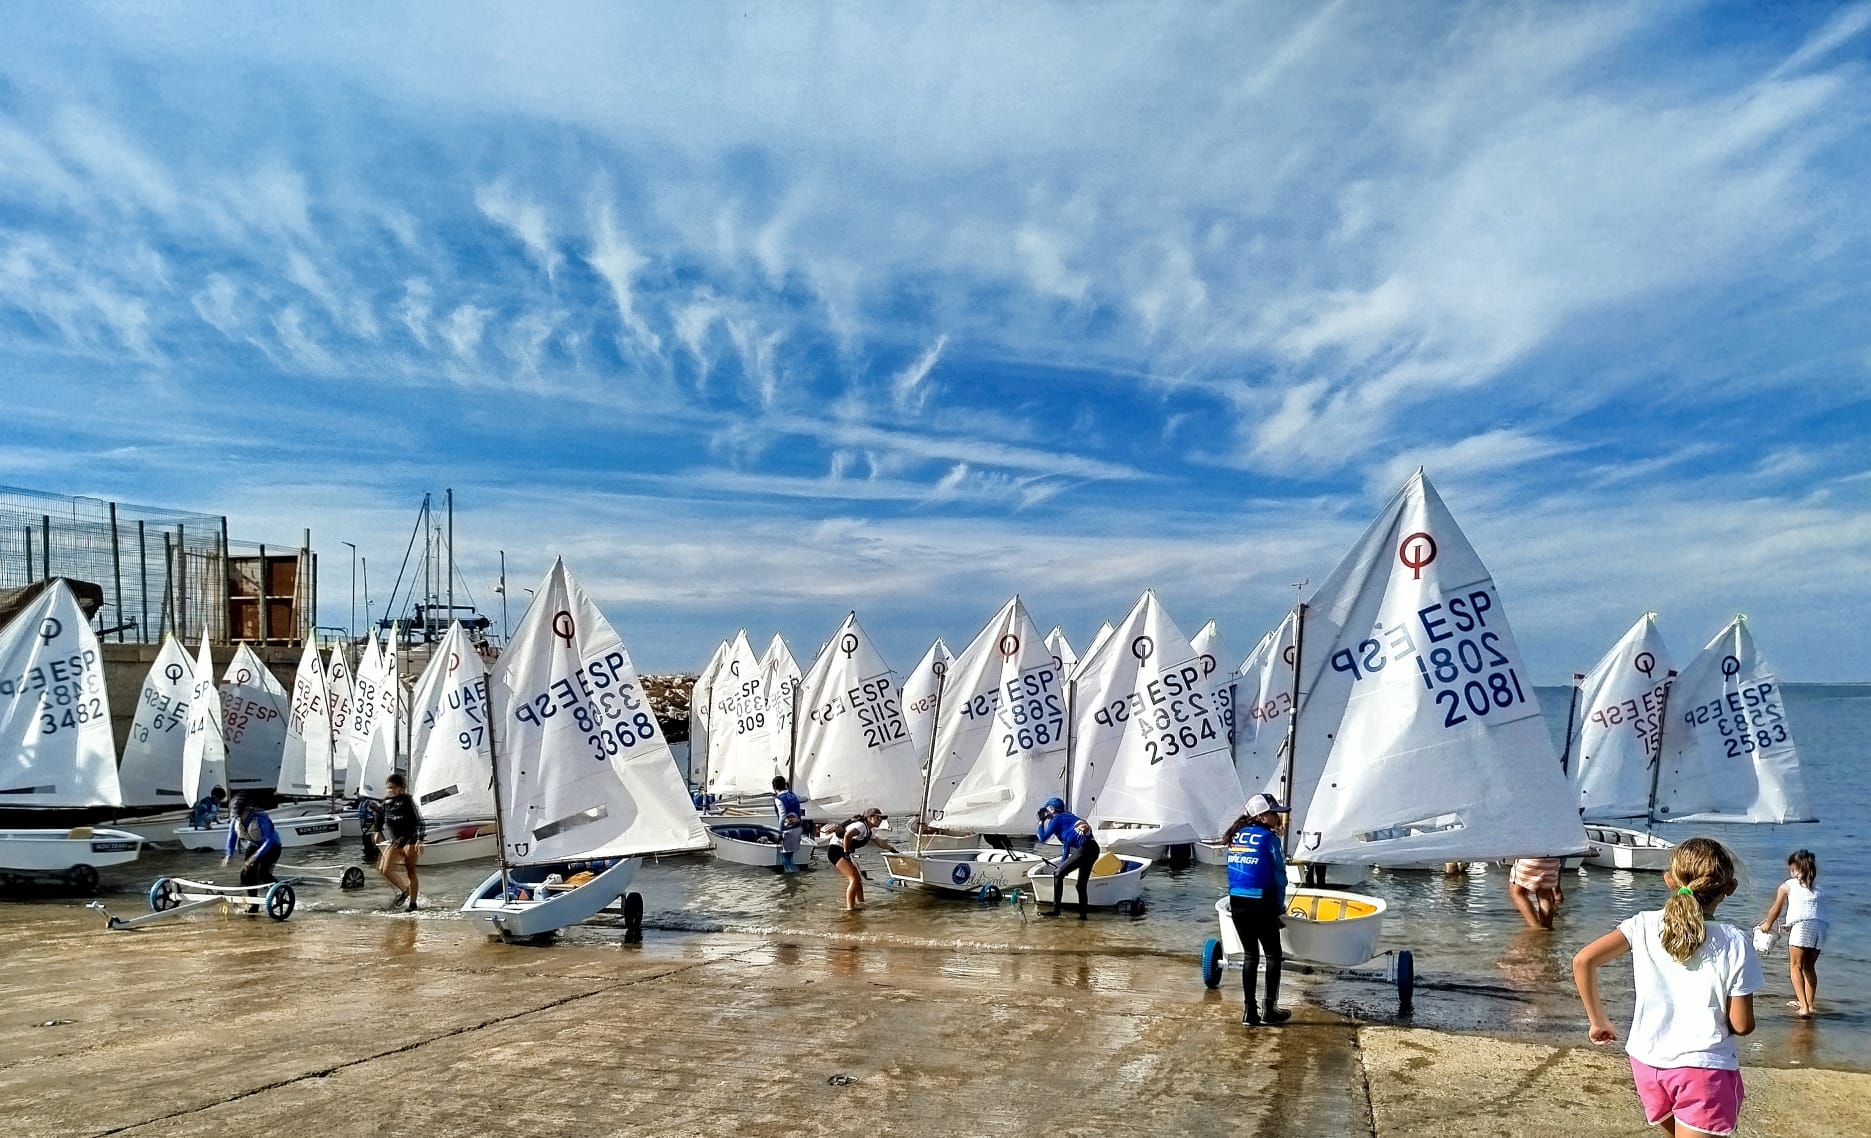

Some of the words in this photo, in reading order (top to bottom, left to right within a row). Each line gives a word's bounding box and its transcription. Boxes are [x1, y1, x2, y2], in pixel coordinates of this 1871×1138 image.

[1417, 590, 1492, 644] ESP
[49, 649, 95, 682] ESP
[575, 652, 624, 698] ESP
[448, 681, 486, 710] UAE
[848, 678, 890, 708] ESP
[1006, 670, 1053, 702] ESP
[1147, 667, 1198, 706] ESP
[1435, 668, 1526, 728] 2081
[1726, 683, 1772, 712] ESP
[40, 698, 103, 734] 3482
[153, 713, 179, 733] 67
[244, 702, 278, 722] ESP
[737, 712, 765, 734] 309
[459, 726, 484, 750] 97
[588, 712, 655, 761] 3368
[863, 719, 906, 748] 2112
[1002, 718, 1063, 757] 2687
[1145, 718, 1216, 765] 2364
[1724, 724, 1787, 758] 2583
